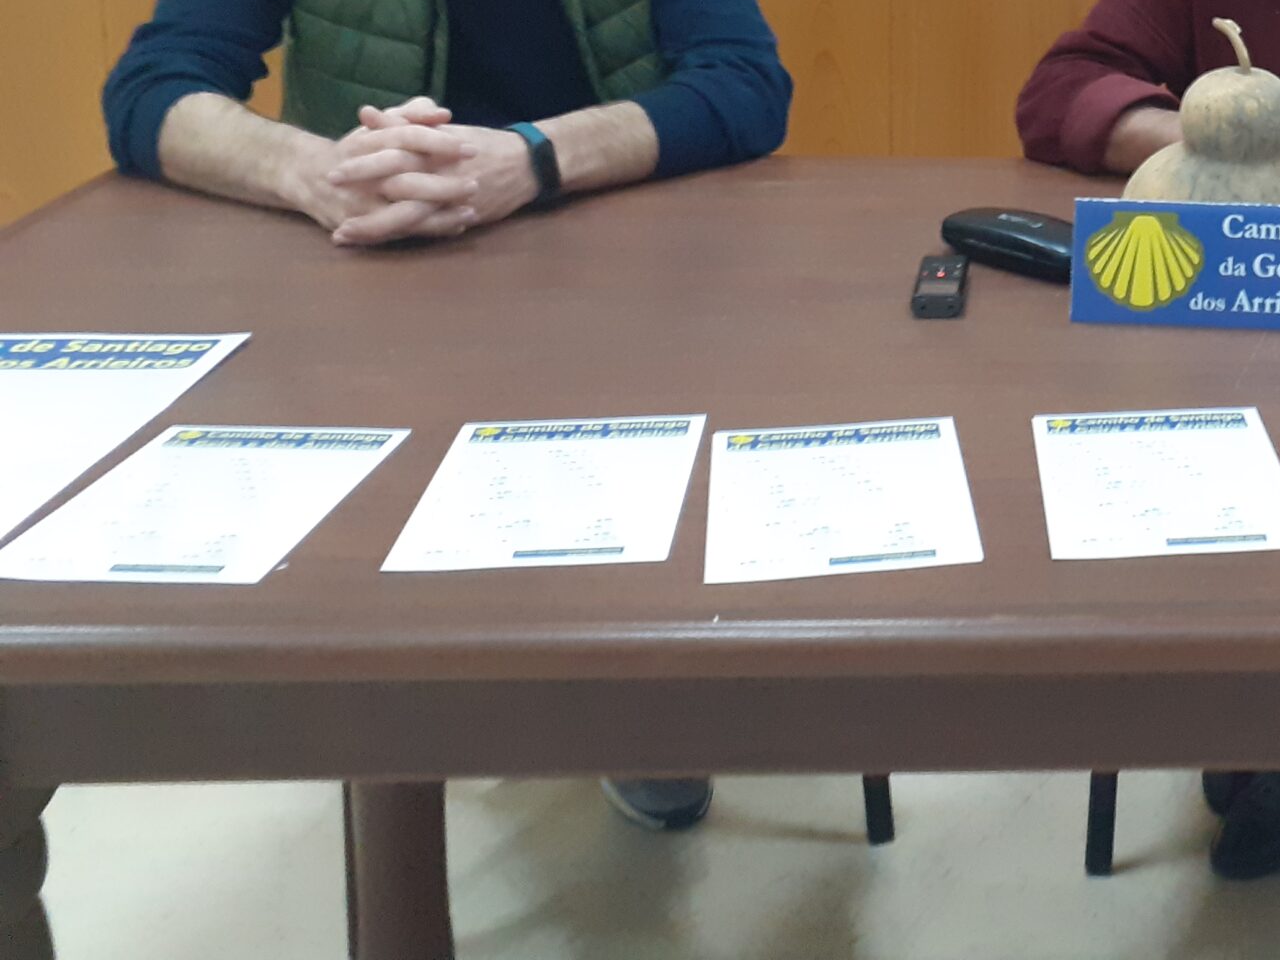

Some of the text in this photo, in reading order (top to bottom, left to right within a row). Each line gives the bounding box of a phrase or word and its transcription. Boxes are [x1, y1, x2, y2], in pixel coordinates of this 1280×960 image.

[1219, 256, 1246, 277] da
[1189, 292, 1226, 311] dos
[9, 340, 213, 356] de Santiago
[0, 358, 36, 369] os
